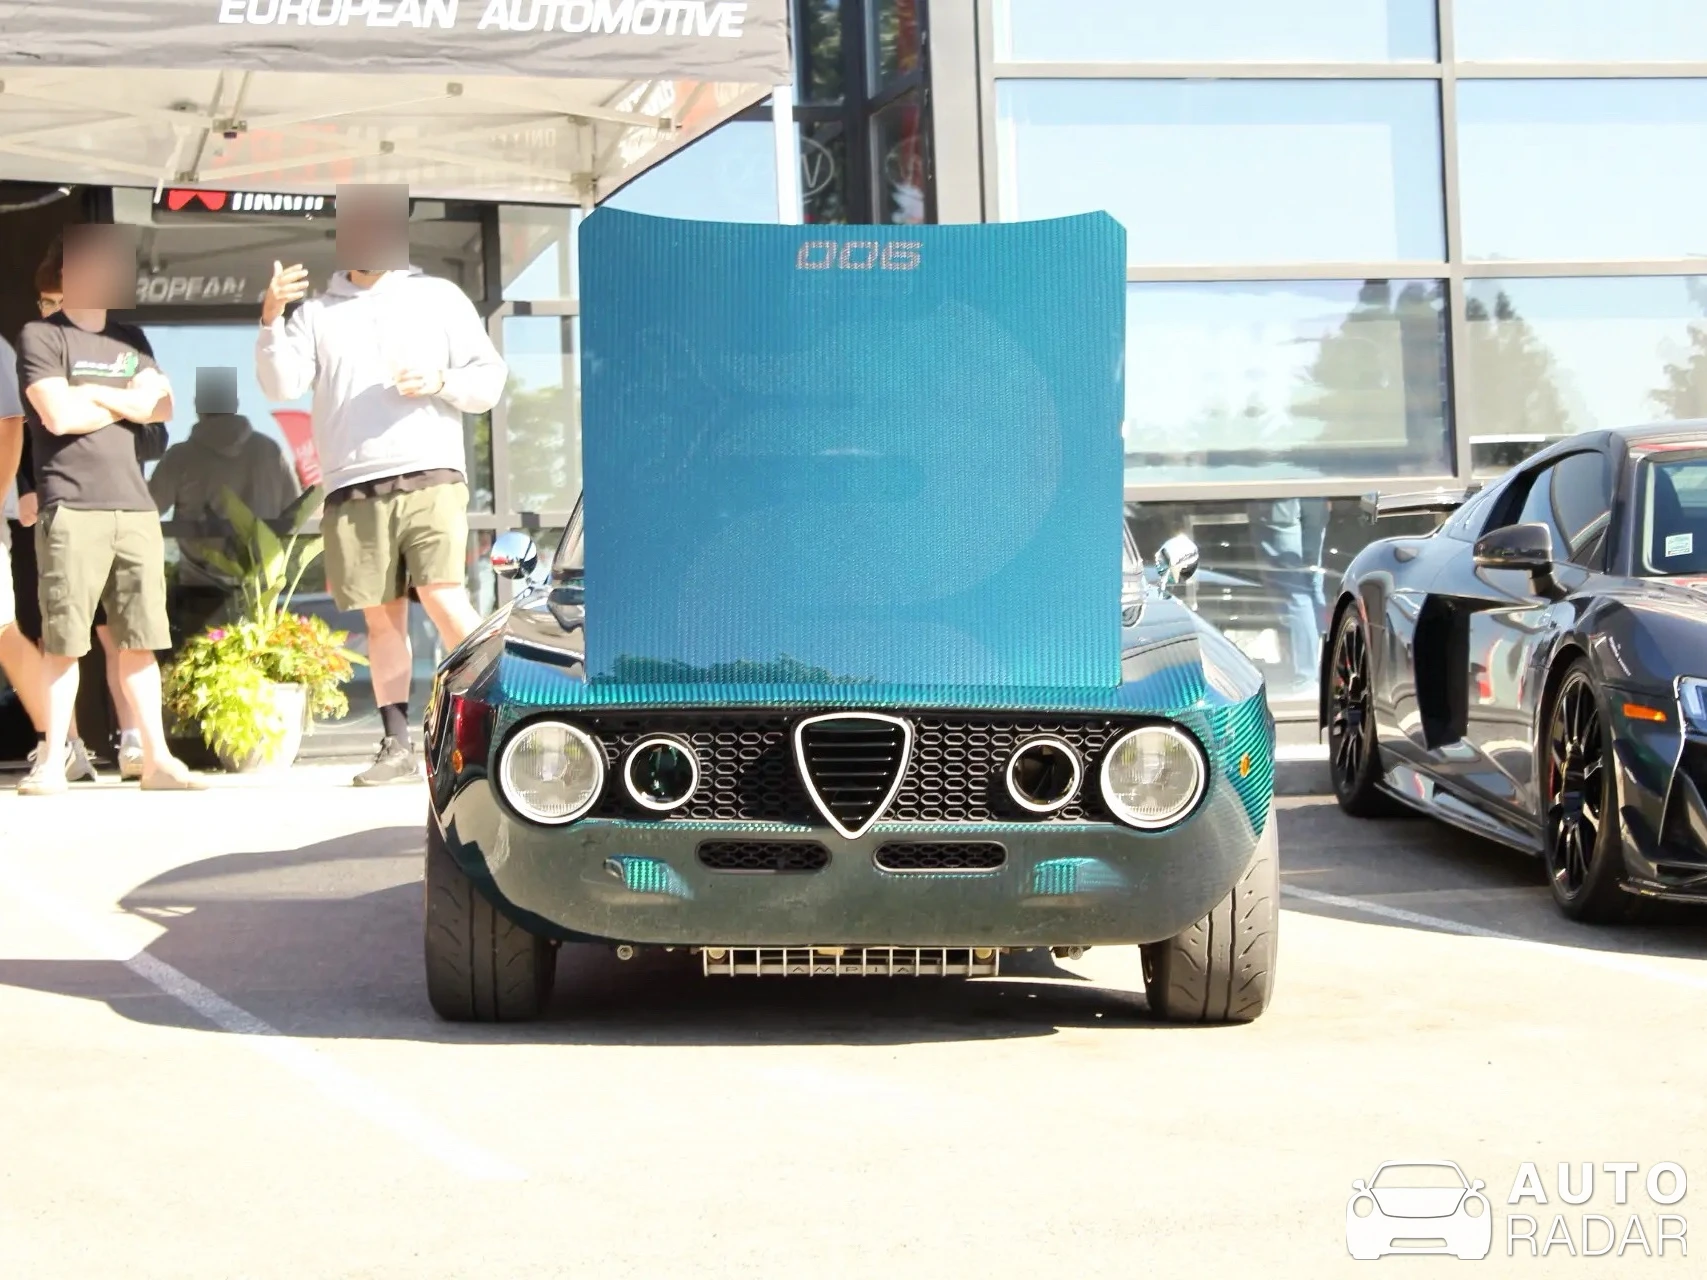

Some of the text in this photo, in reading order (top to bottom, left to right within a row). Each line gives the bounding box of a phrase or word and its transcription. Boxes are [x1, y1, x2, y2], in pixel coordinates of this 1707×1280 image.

[218, 0, 748, 38] EUROPEAN AUTOMOTIVE
[796, 240, 924, 269] 006
[136, 276, 246, 303] ROPEAN
